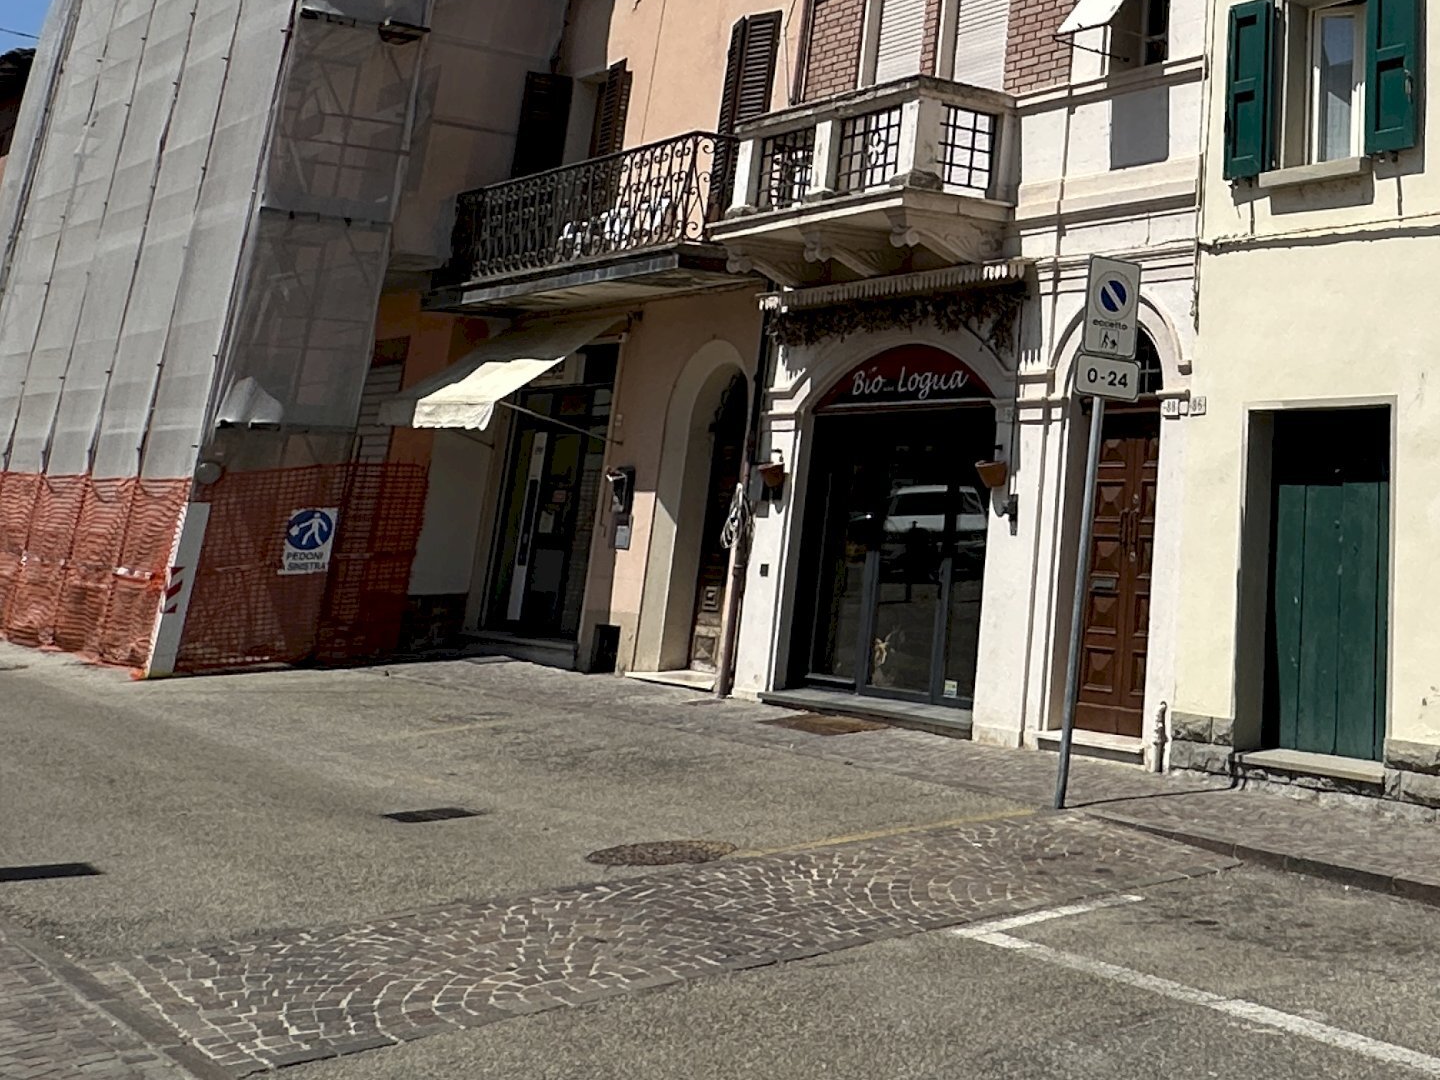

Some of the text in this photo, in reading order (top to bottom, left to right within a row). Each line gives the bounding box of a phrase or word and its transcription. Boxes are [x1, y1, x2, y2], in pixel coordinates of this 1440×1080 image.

[1092, 318, 1129, 331] eccetto
[852, 366, 969, 400] Bio Logua
[1087, 367, 1129, 389] 0-24
[286, 551, 325, 561] PEDONI
